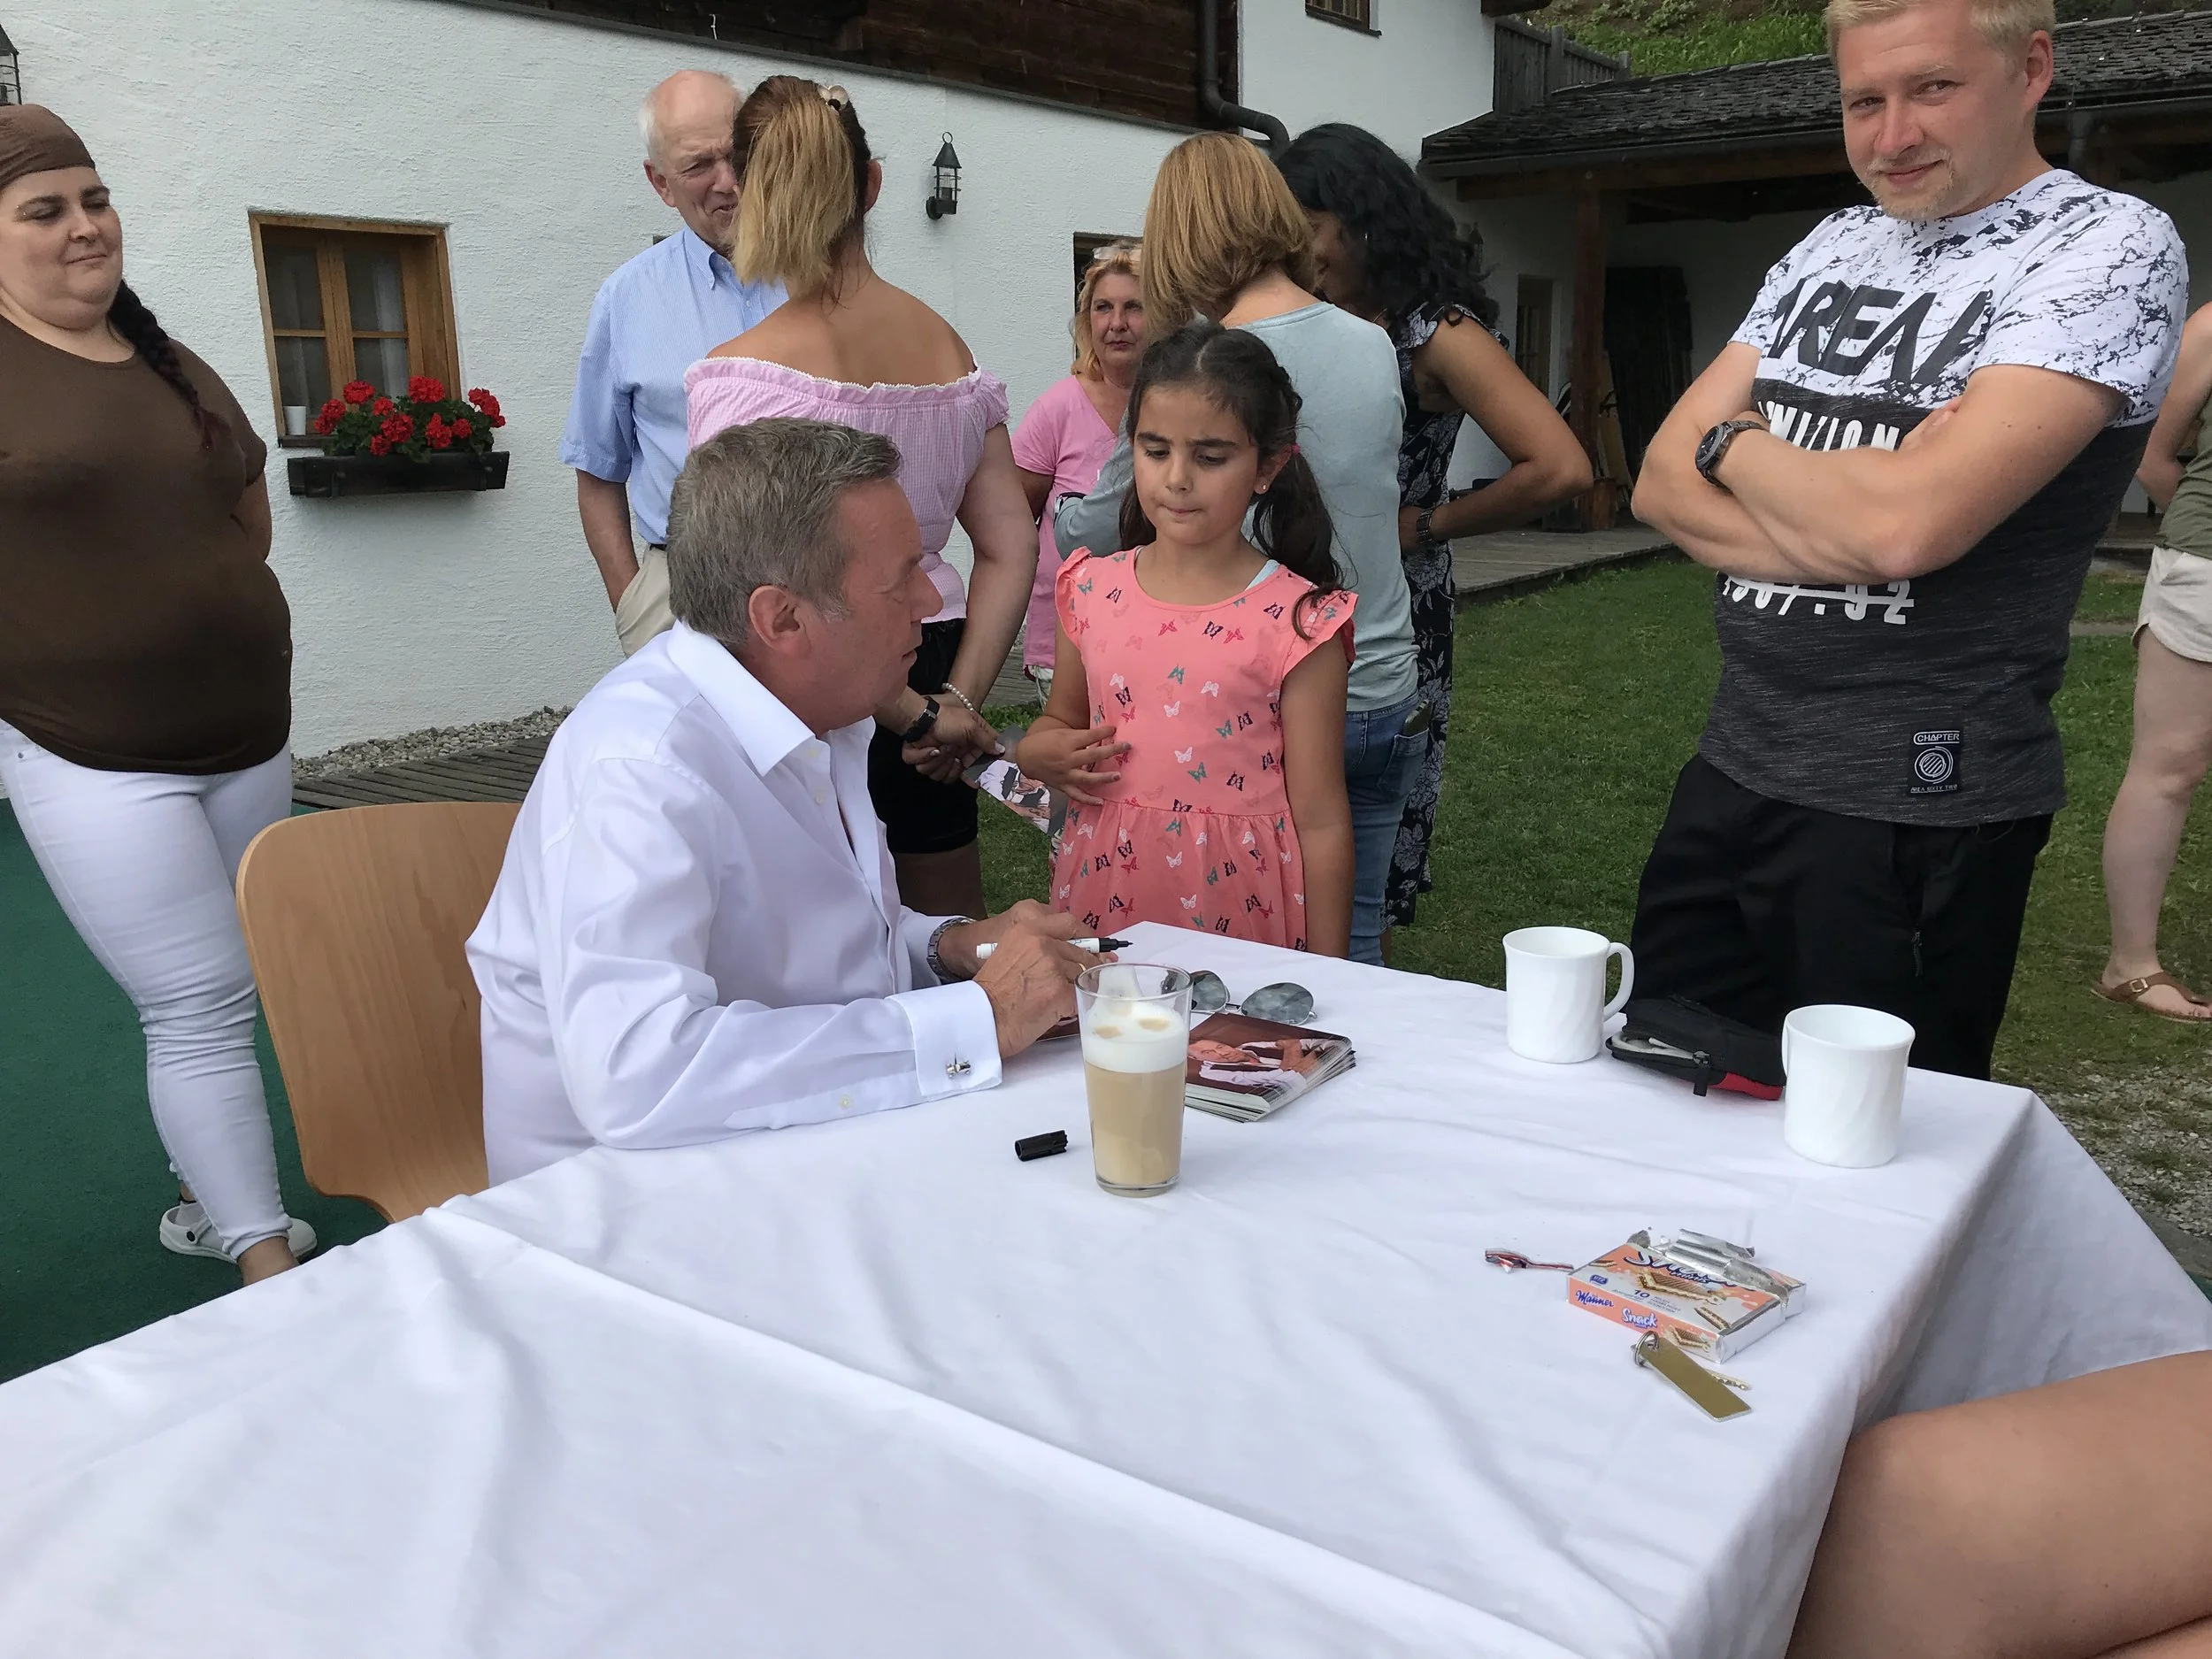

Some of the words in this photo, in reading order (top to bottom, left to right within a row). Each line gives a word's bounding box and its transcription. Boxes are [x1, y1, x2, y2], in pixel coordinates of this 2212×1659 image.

[1916, 733, 1960, 742] CHAPTER
[1575, 1289, 1615, 1308] Manner
[1634, 1289, 1650, 1298] 10
[1622, 1307, 1659, 1327] Snack
